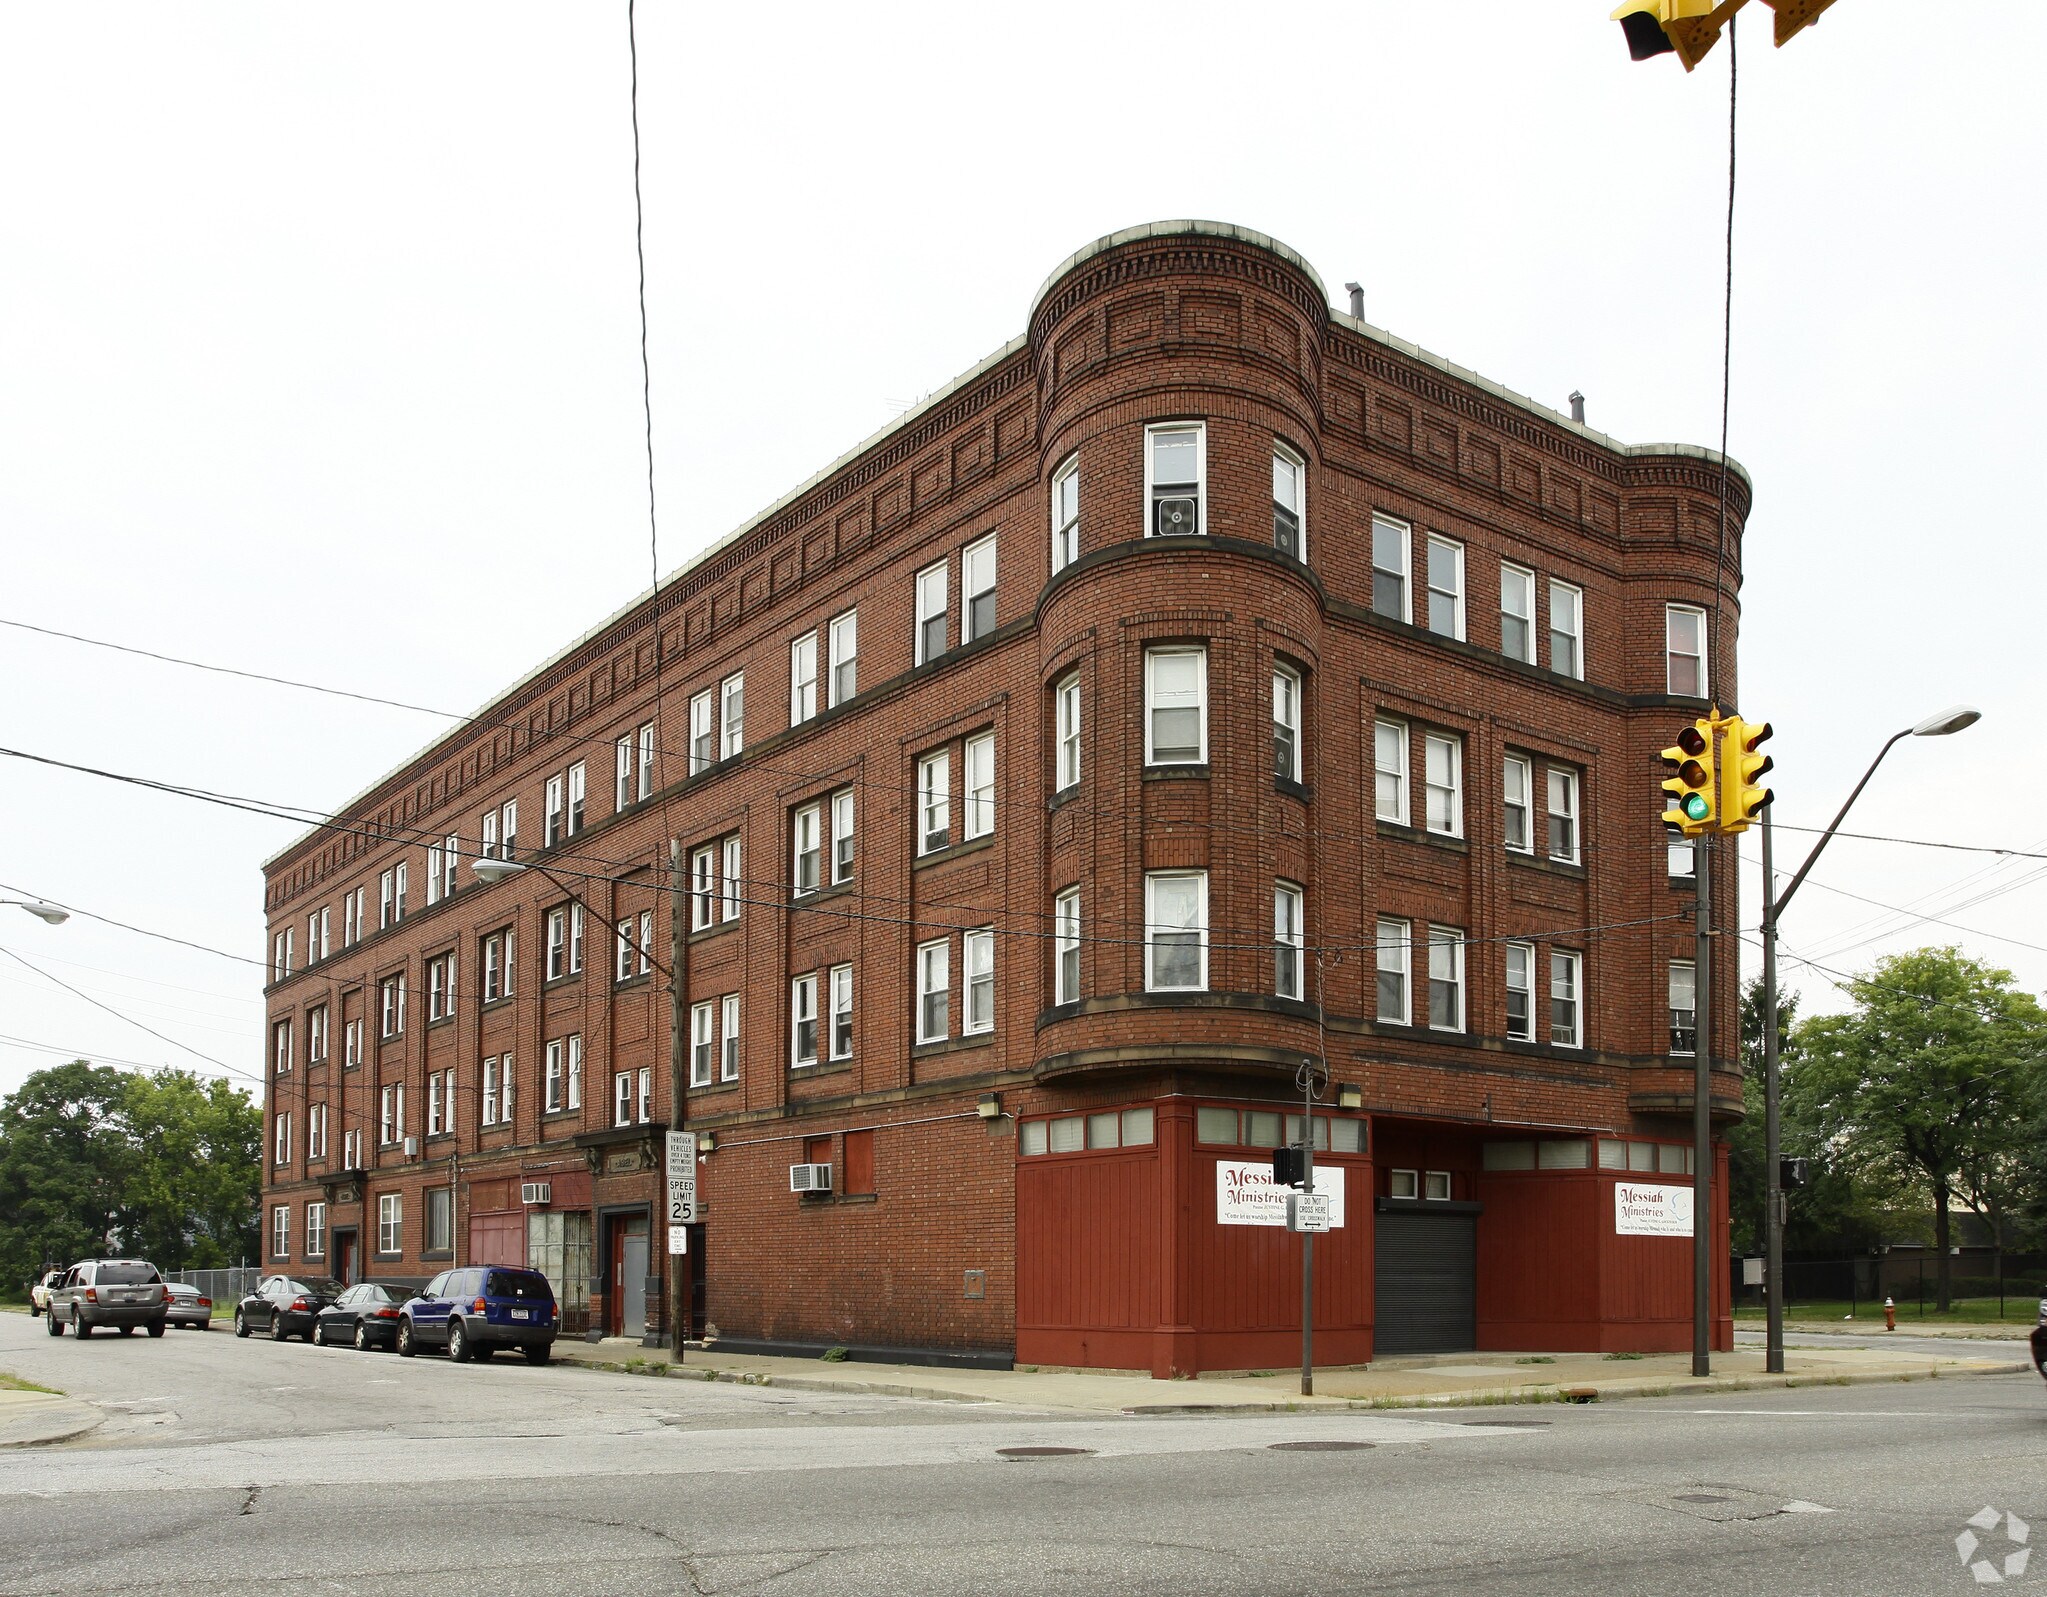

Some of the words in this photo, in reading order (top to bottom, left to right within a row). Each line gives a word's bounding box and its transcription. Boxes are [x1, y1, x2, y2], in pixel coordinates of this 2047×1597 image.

[670, 1136, 691, 1144] THROUGH
[670, 1145, 692, 1153] VEHICLES
[670, 1165, 692, 1174] PROHIBITED
[670, 1181, 694, 1191] SPEED
[673, 1192, 692, 1201] LIMIT
[1227, 1188, 1288, 1205] Ministrie
[1620, 1187, 1664, 1203] Messiah
[1312, 1197, 1322, 1205] NOT
[673, 1203, 692, 1219] 25
[1299, 1206, 1314, 1214] CROSS
[1315, 1206, 1326, 1214] HERE
[1621, 1205, 1665, 1219] Ministries
